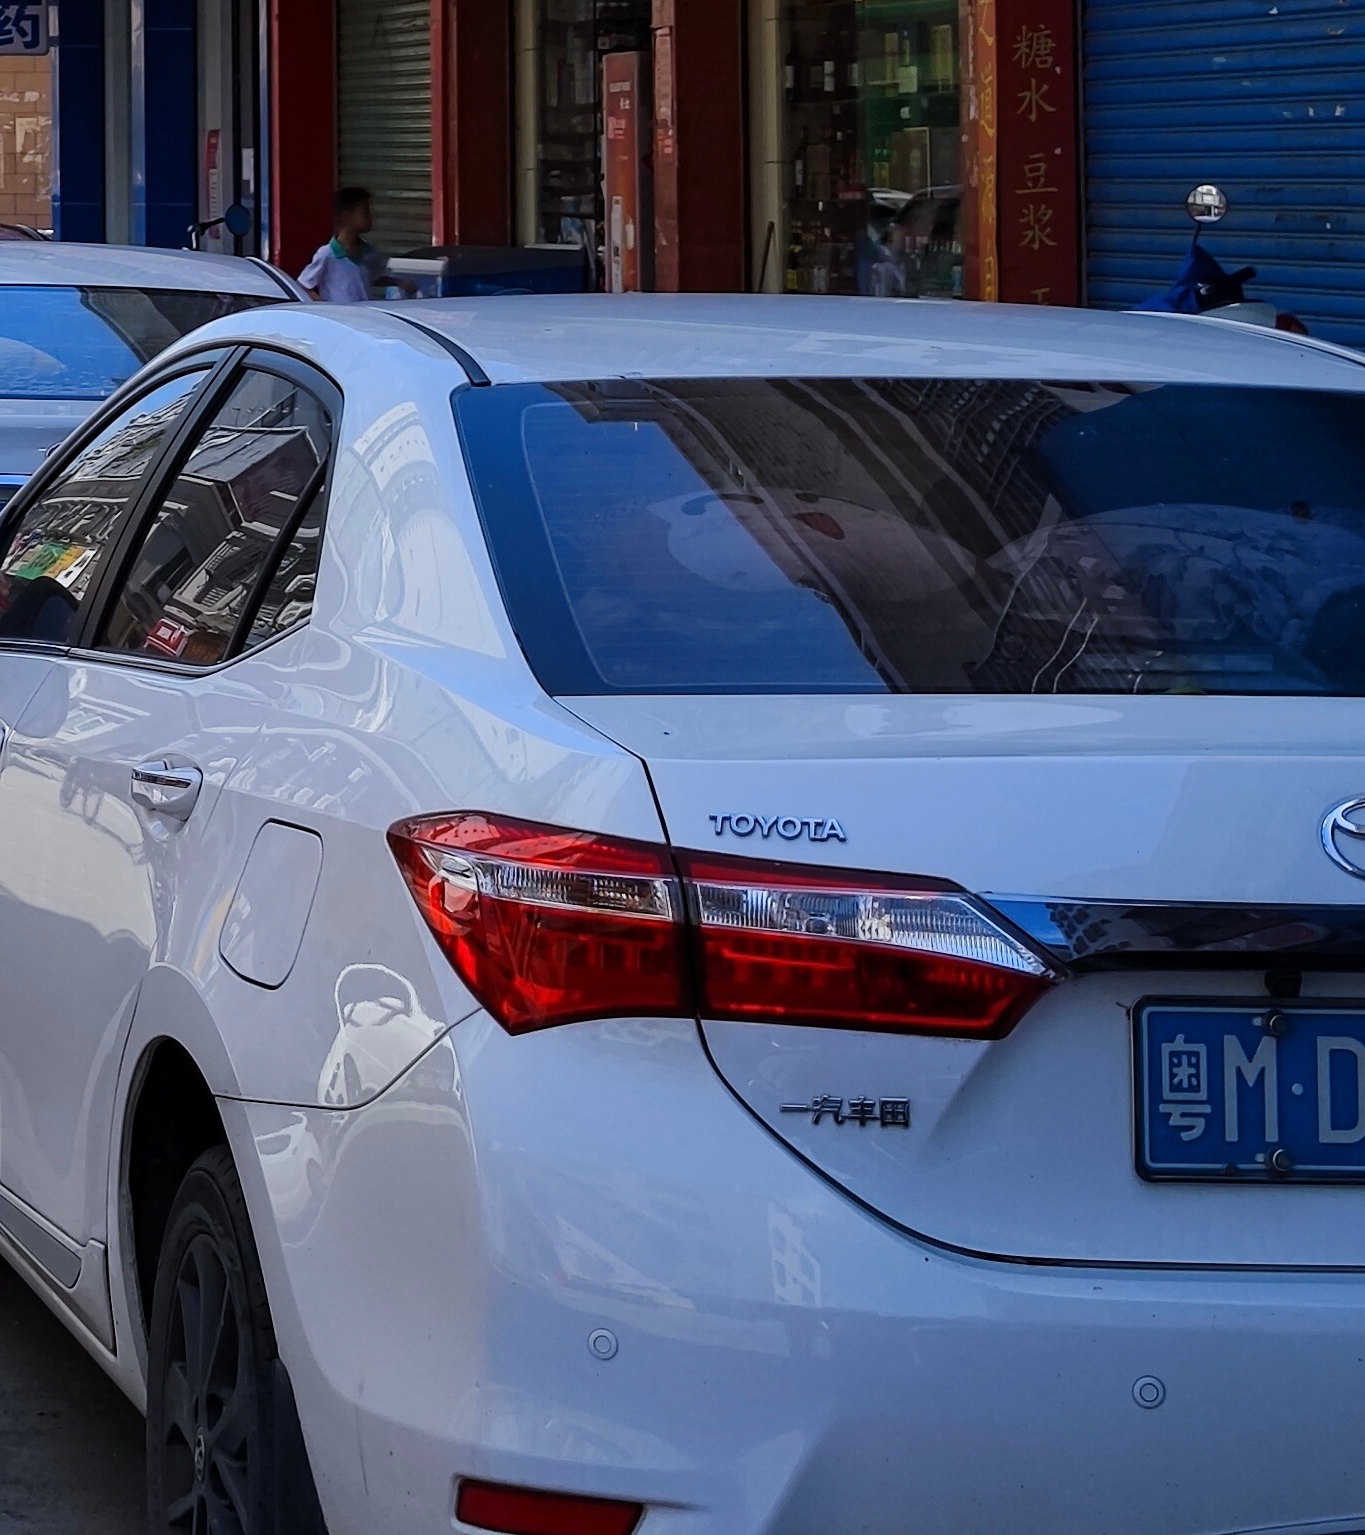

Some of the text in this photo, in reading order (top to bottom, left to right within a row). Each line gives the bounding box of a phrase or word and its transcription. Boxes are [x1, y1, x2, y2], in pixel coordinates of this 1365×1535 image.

[1012, 22, 1058, 124] 糖水
[1015, 151, 1059, 250] 豆浆
[709, 812, 848, 842] TOYOTA
[780, 1094, 911, 1128] 一汽丰田
